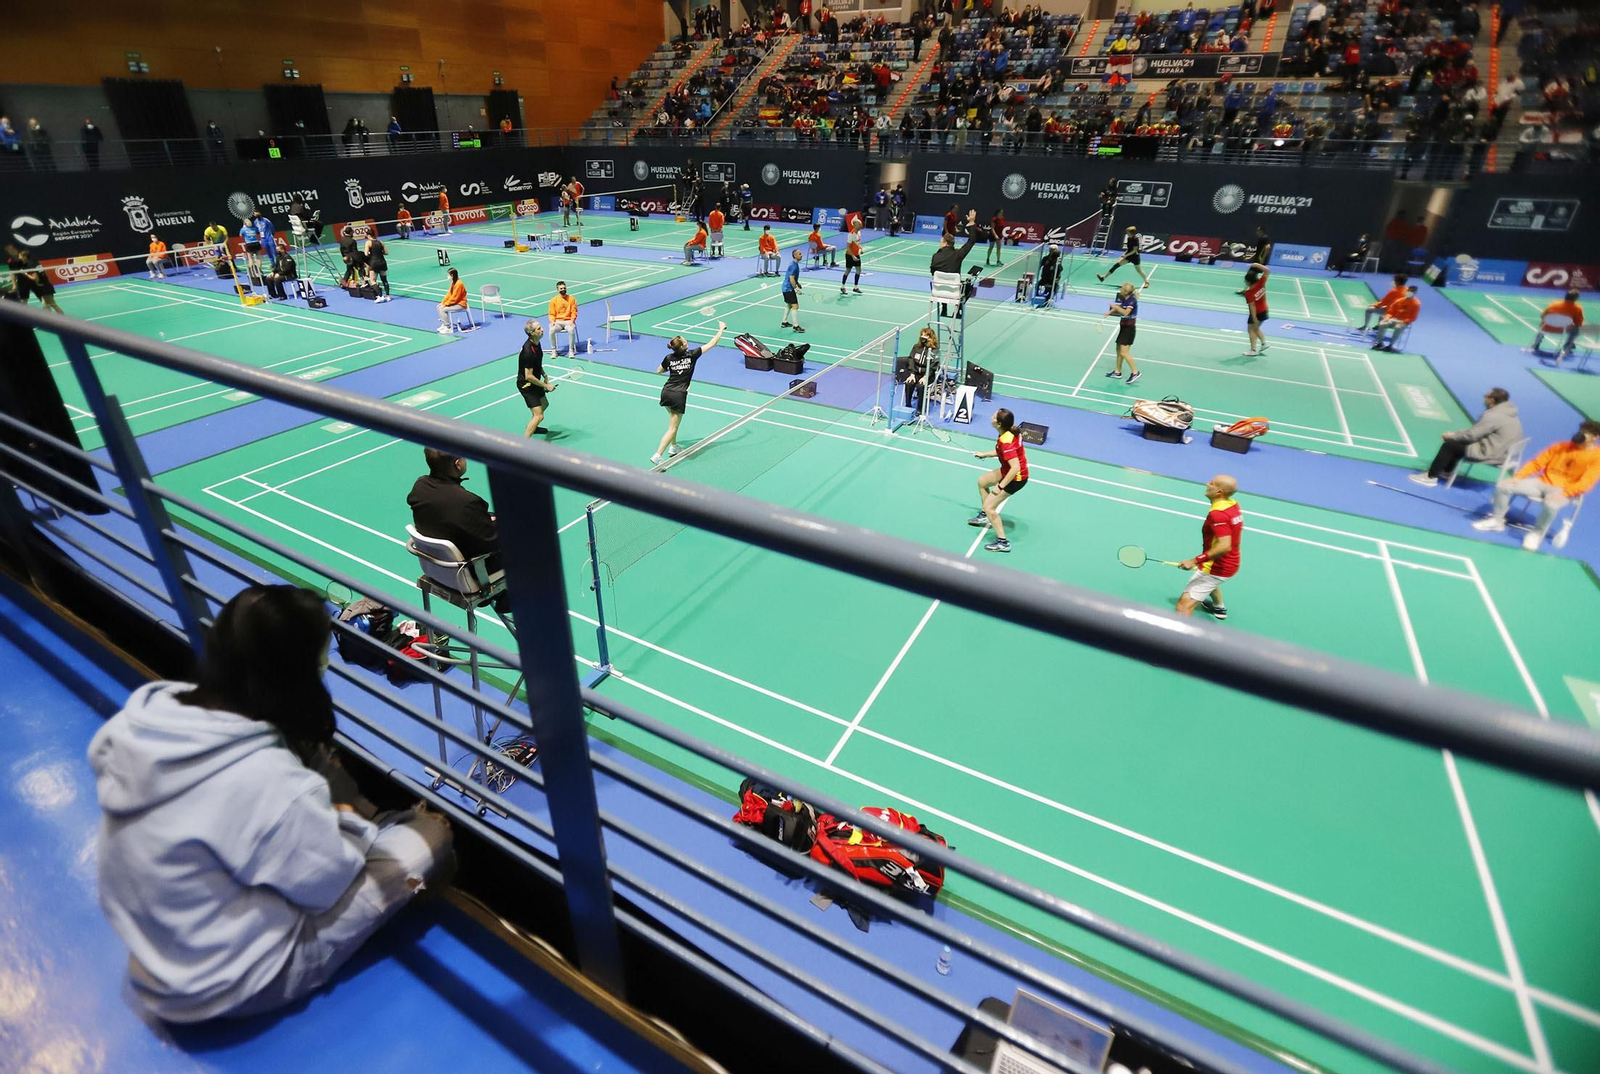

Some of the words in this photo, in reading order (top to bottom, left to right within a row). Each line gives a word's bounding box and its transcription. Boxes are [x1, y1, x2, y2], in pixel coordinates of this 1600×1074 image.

[1150, 57, 1195, 68] HUELVA'21
[782, 170, 819, 179] HUELVA'21
[1030, 182, 1081, 193] HUELVA'21
[365, 195, 392, 204] HUELVA
[1037, 192, 1070, 201] ESPAÑA
[1248, 194, 1313, 207] HUELVA'21
[1257, 205, 1298, 215] ESPAÑA
[156, 215, 196, 227] HUELVA
[453, 210, 486, 222] TOYOTA
[48, 215, 102, 230] Andalucía
[958, 408, 967, 419] 2
